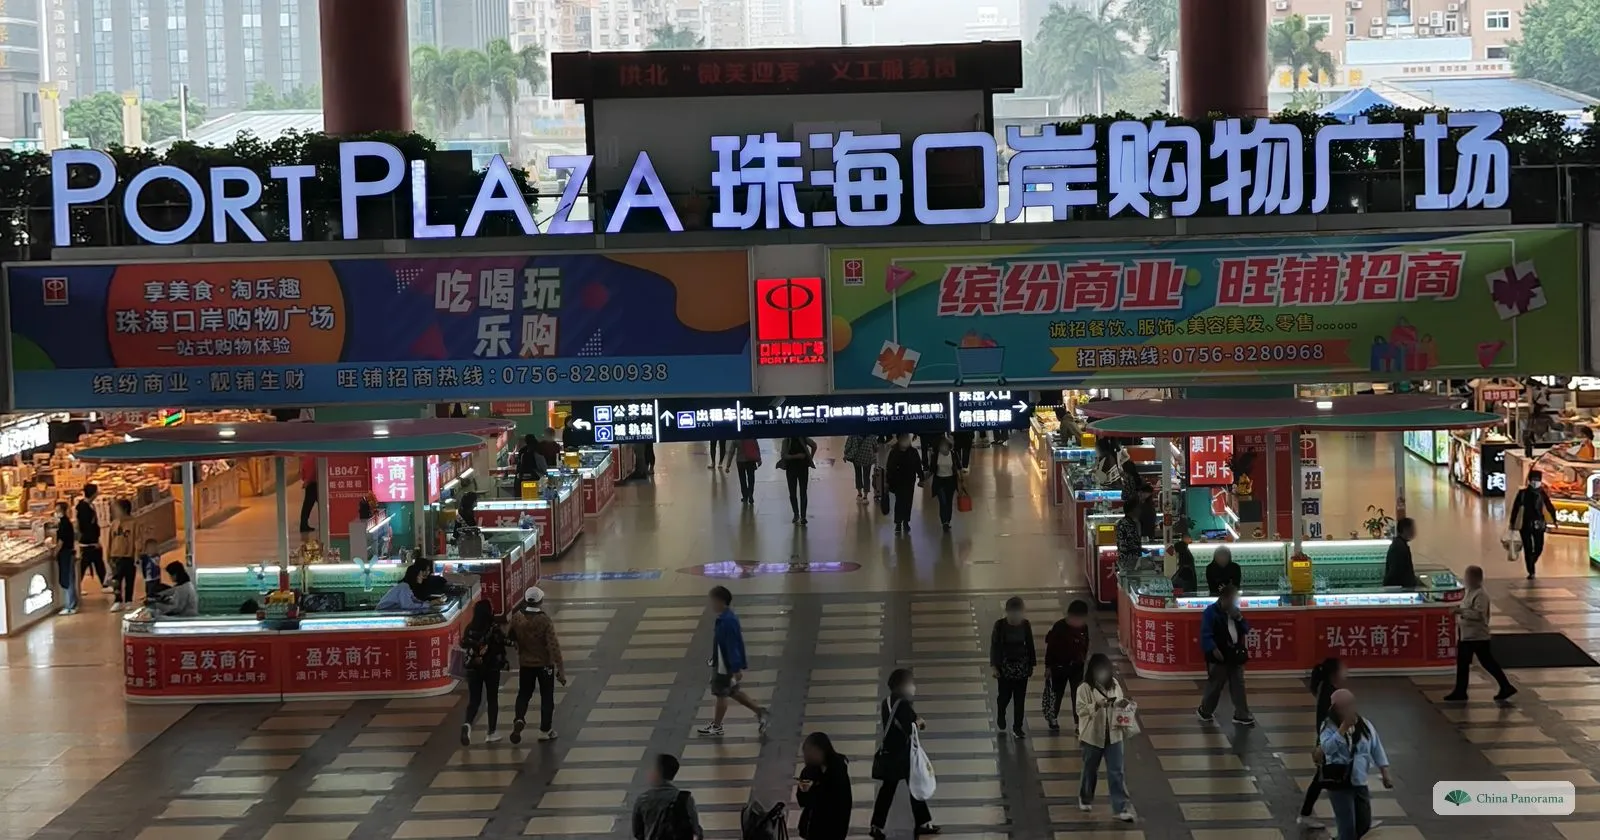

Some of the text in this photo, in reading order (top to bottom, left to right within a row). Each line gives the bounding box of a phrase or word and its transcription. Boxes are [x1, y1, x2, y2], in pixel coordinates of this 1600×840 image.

[831, 57, 956, 82] 义工服务岗
[711, 111, 1511, 229] 珠海口岸购物广场
[51, 141, 684, 247] PORT PLAZA
[434, 267, 561, 312] 吃喝玩
[936, 249, 1467, 317] 缤纷商业 旺铺招商
[115, 305, 336, 334] 珠海口岸购物广场
[473, 313, 558, 358] 乐购
[156, 337, 292, 358] 一站式购物体验
[613, 403, 653, 418] 公交站
[696, 407, 737, 422] 出租车
[1191, 435, 1232, 454] 澳门卡
[329, 465, 359, 476] LB047
[1191, 460, 1232, 479] 上网卡
[1326, 624, 1411, 649] 弘兴商行
[180, 649, 257, 670] 盈发商行
[305, 646, 382, 667] 盈发商行
[337, 668, 392, 680] 大陆上网卡
